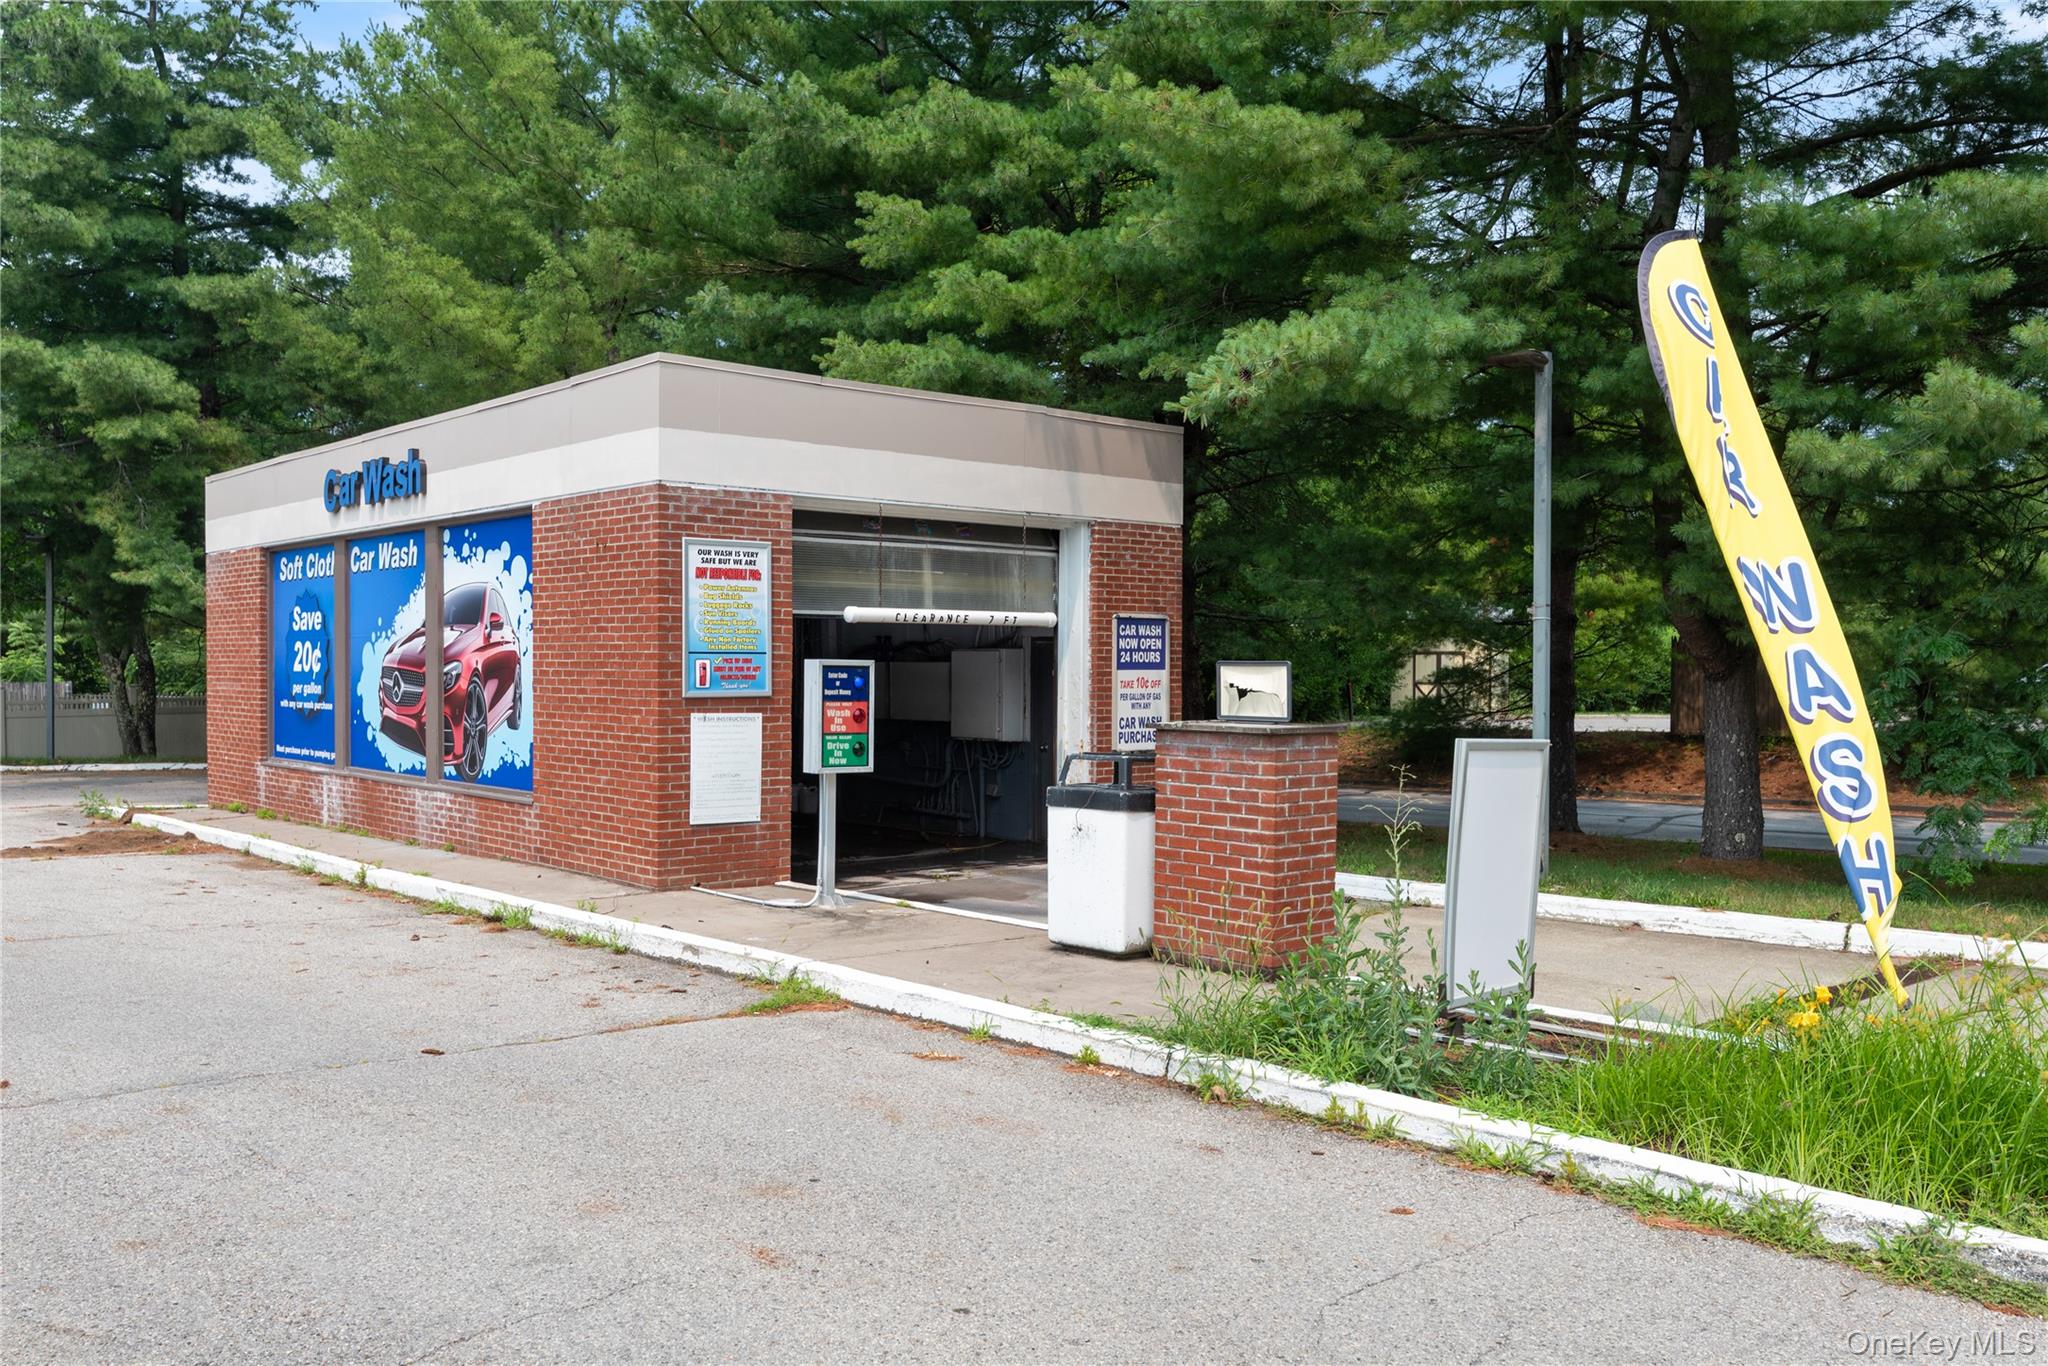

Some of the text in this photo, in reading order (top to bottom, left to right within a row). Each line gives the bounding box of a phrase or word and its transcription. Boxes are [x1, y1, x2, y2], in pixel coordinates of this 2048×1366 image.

[324, 448, 427, 513] Car Wash
[280, 555, 303, 581] Soft
[350, 545, 376, 573] Car
[379, 539, 418, 570] Wash
[695, 567, 708, 579] NOT
[709, 567, 747, 580] RESPONSIBLE
[703, 583, 725, 592] Power
[703, 592, 743, 601] Bug Shields
[703, 601, 732, 610] Luggage
[703, 609, 717, 617] Sun
[292, 606, 322, 632] Save
[703, 618, 757, 627] Running Boards
[895, 612, 1018, 625] CLEARANCE 7 FT
[703, 626, 724, 634] Glued
[735, 627, 761, 636] Spoilers
[1119, 625, 1162, 636] CAR WASH
[703, 635, 717, 643] Any
[733, 635, 757, 644] Factory
[1119, 638, 1162, 649] NOW OPEN
[293, 640, 322, 680] 20¢
[1120, 651, 1161, 663] 24 HOURS
[1120, 680, 1135, 689] TAKE
[1150, 679, 1161, 688] OFF
[292, 682, 321, 697] per gallon
[1119, 692, 1161, 701] PER GALLON OF GAS
[280, 699, 289, 707] with
[303, 700, 314, 709] wash
[314, 701, 333, 711] purchase
[1130, 702, 1142, 710] WITH
[827, 709, 851, 717] Wash
[830, 724, 847, 732] Use
[1119, 717, 1136, 730] CAR
[1118, 730, 1157, 744] PURCHAS
[1737, 555, 1894, 922] WASH
[827, 742, 850, 750] Drive
[829, 757, 847, 765] Now
